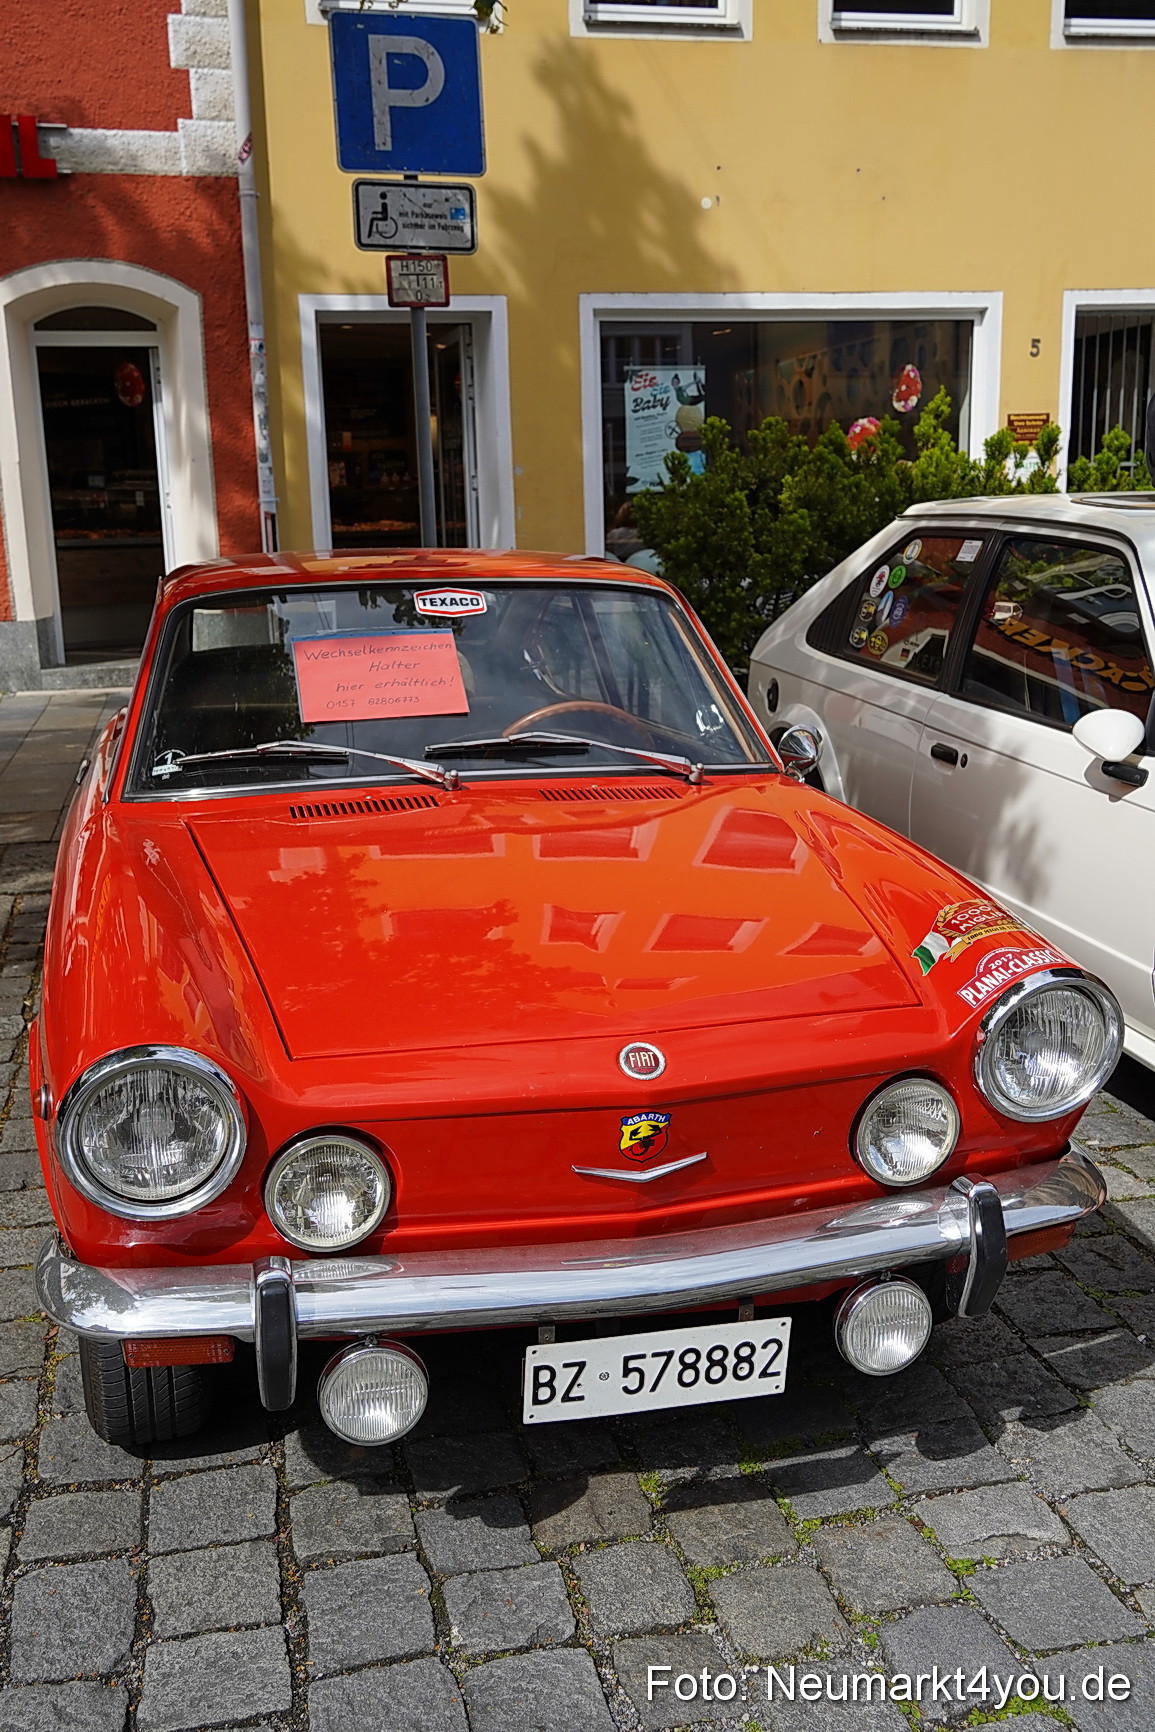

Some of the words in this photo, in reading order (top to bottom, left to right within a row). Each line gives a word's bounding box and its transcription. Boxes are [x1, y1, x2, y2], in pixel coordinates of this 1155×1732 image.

[368, 34, 445, 151] P
[1029, 338, 1041, 358] 5
[631, 395, 672, 414] Baby
[418, 597, 480, 608] TEXACO
[303, 642, 452, 661] Wechselkennzeichen
[368, 661, 421, 673] Halter
[336, 682, 364, 693] hier
[326, 699, 356, 710] 0157
[368, 696, 420, 706] 82806773
[951, 905, 991, 925] 1000
[988, 953, 1014, 970] 2017
[628, 1051, 656, 1068] FIAT
[627, 1113, 666, 1126] ABARTH
[531, 1360, 587, 1406] BZ
[621, 1337, 784, 1396] 578882
